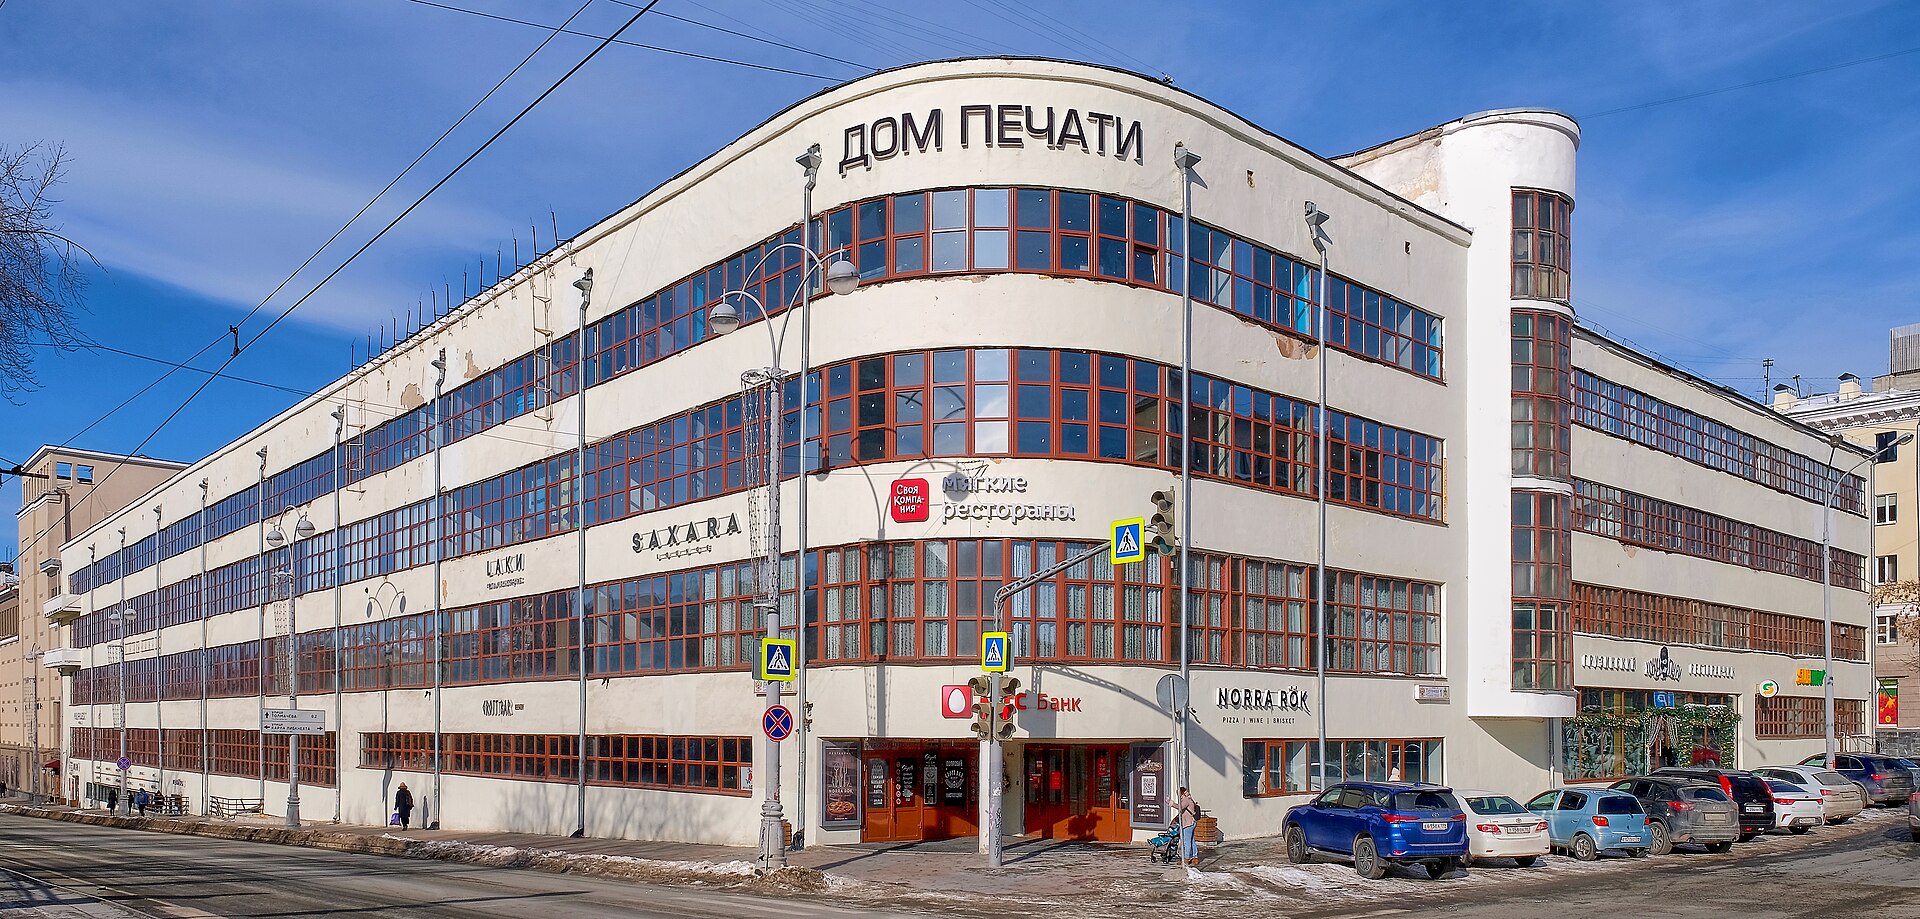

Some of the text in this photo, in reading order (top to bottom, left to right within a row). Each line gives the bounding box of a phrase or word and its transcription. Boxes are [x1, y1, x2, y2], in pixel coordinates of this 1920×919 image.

[839, 104, 1143, 178] ДОМ ПЕЧАТИ
[943, 476, 1028, 493] мягкие
[943, 502, 1076, 525] рестораны
[632, 513, 742, 553] SAXARA
[1037, 693, 1082, 712] Банк
[1217, 685, 1312, 716] NORRA RÖK
